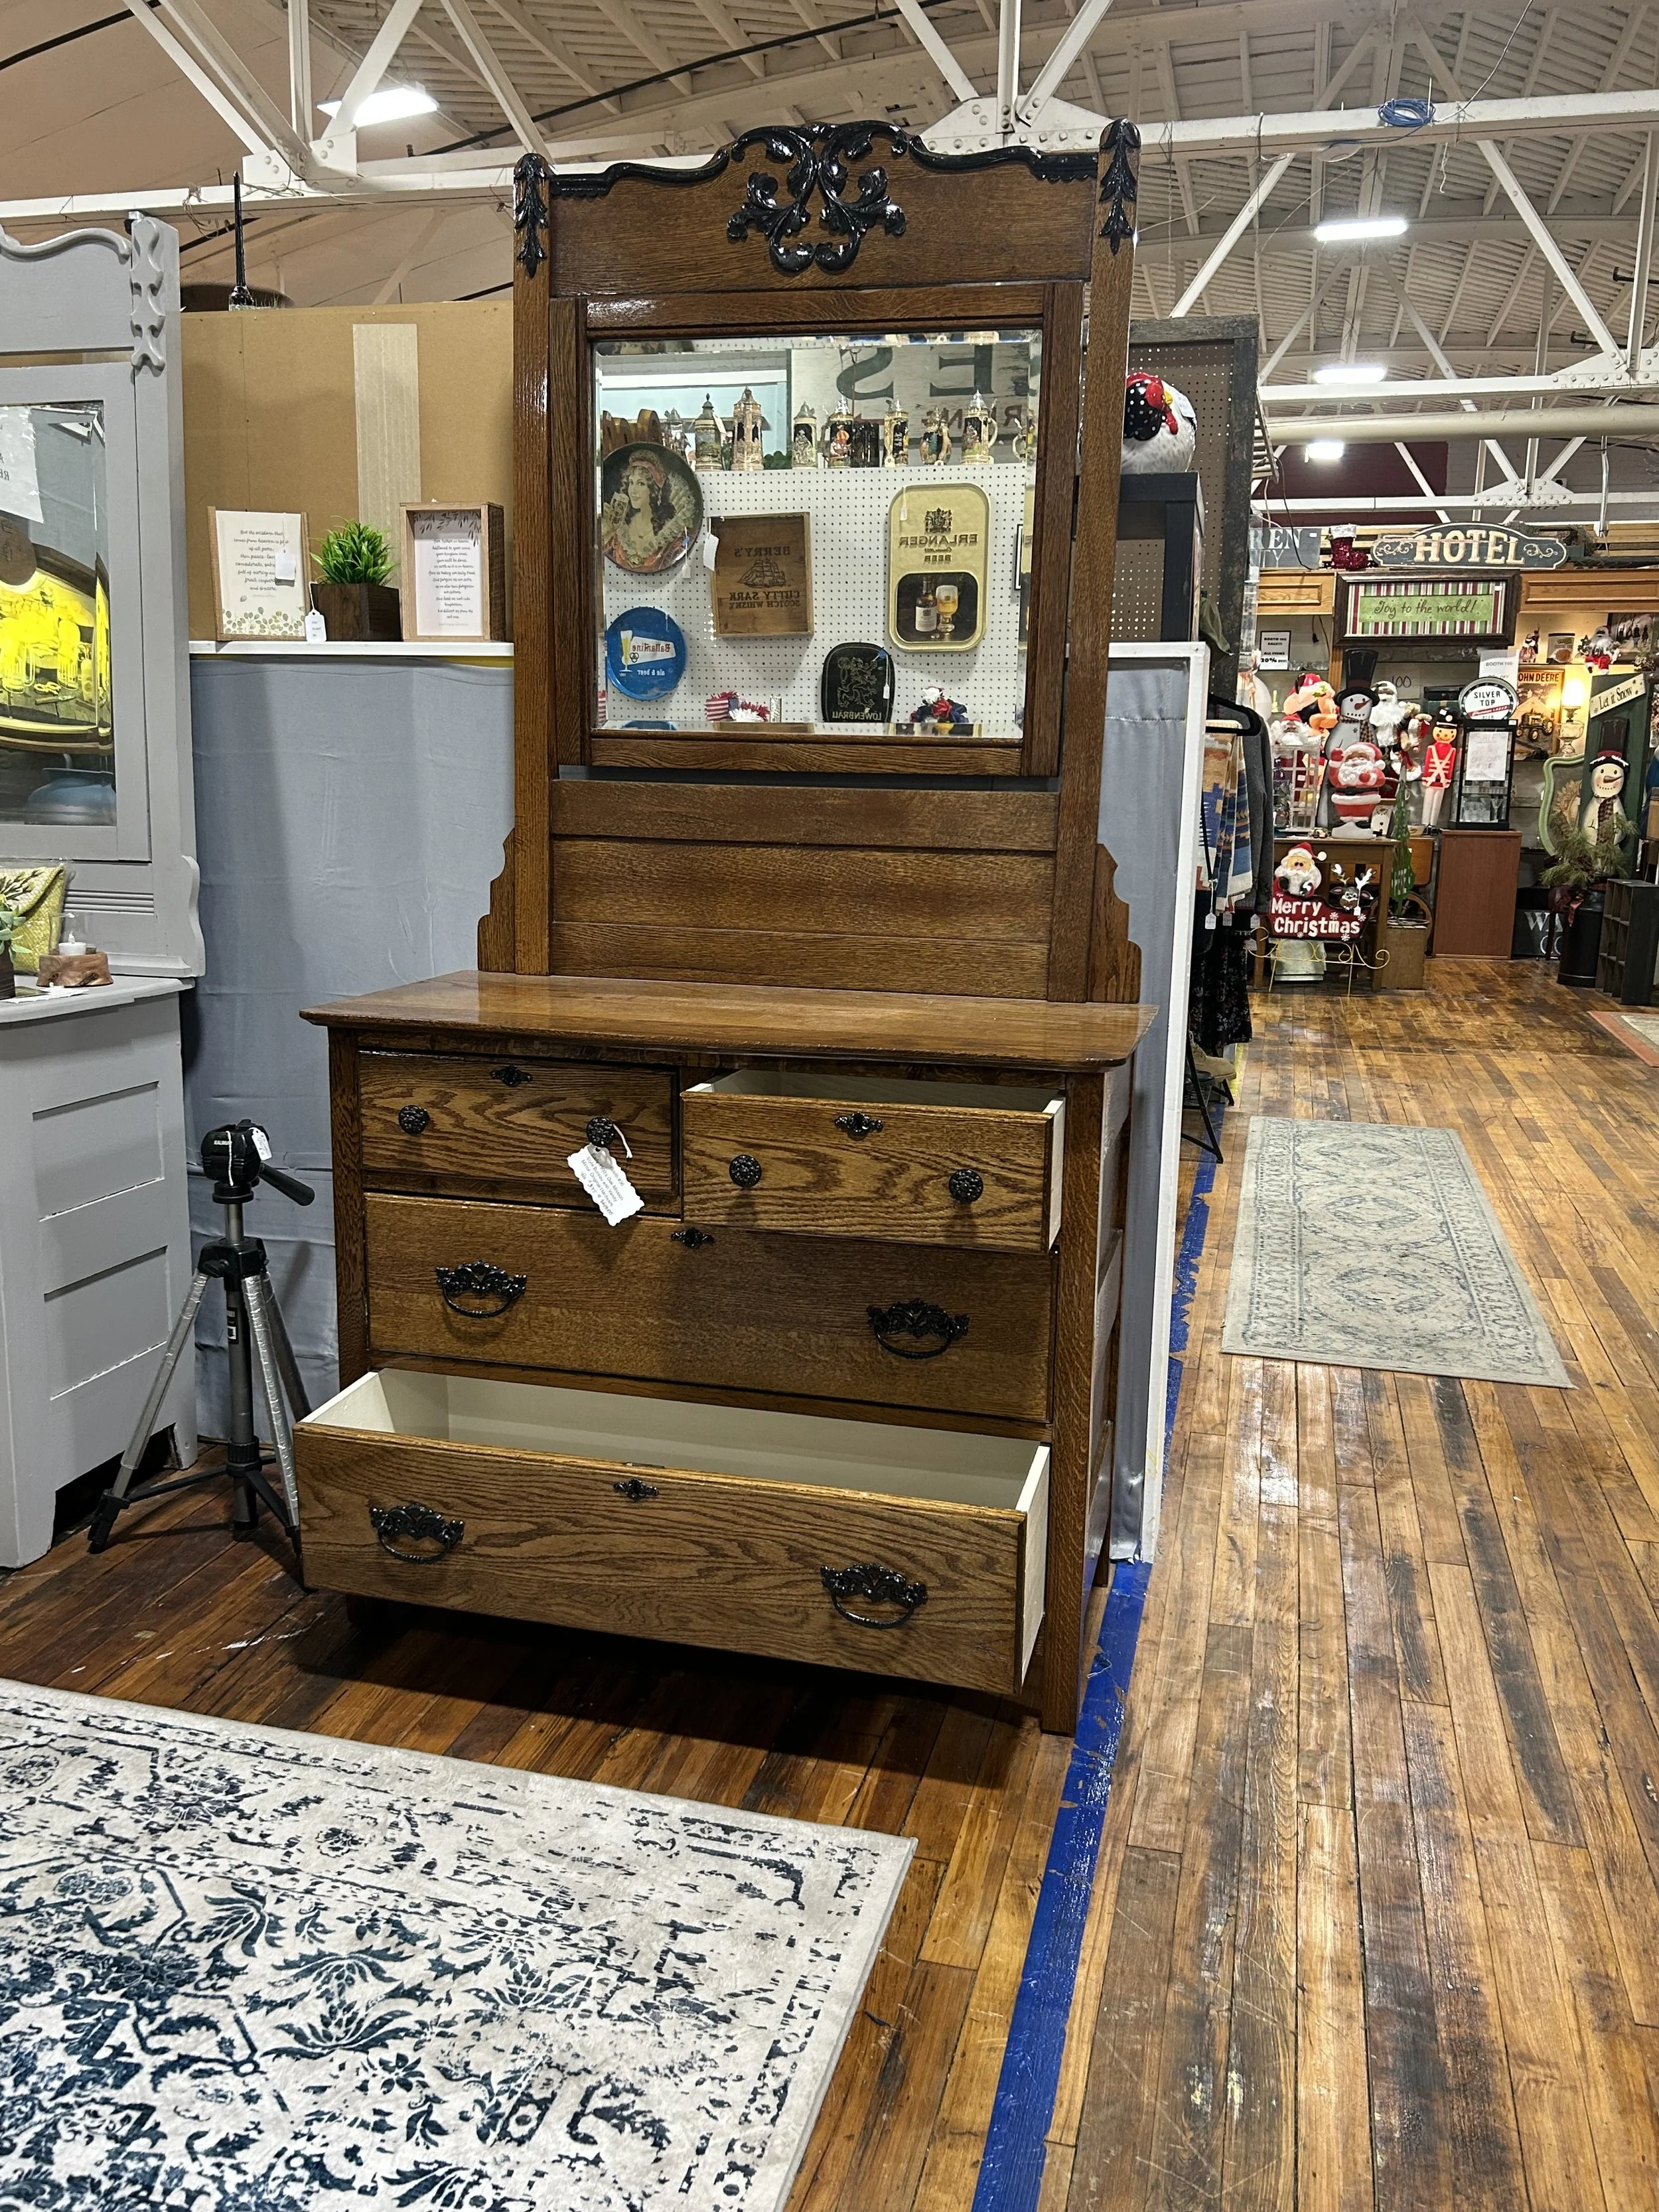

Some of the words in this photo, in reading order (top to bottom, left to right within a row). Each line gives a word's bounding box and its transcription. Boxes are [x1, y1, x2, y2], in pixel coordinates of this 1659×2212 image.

[1414, 530, 1525, 565] HOTEL
[1374, 600, 1396, 619] Joy
[1402, 601, 1411, 613] to
[1415, 599, 1432, 614] the
[1437, 599, 1478, 613] world!
[1518, 672, 1534, 682] OHN
[1536, 672, 1559, 682] DEERE
[1599, 696, 1610, 709] Let
[1610, 692, 1616, 704] it
[1617, 687, 1632, 701] Snow
[1271, 898, 1322, 917] Merry
[1274, 917, 1360, 937] Christmas
